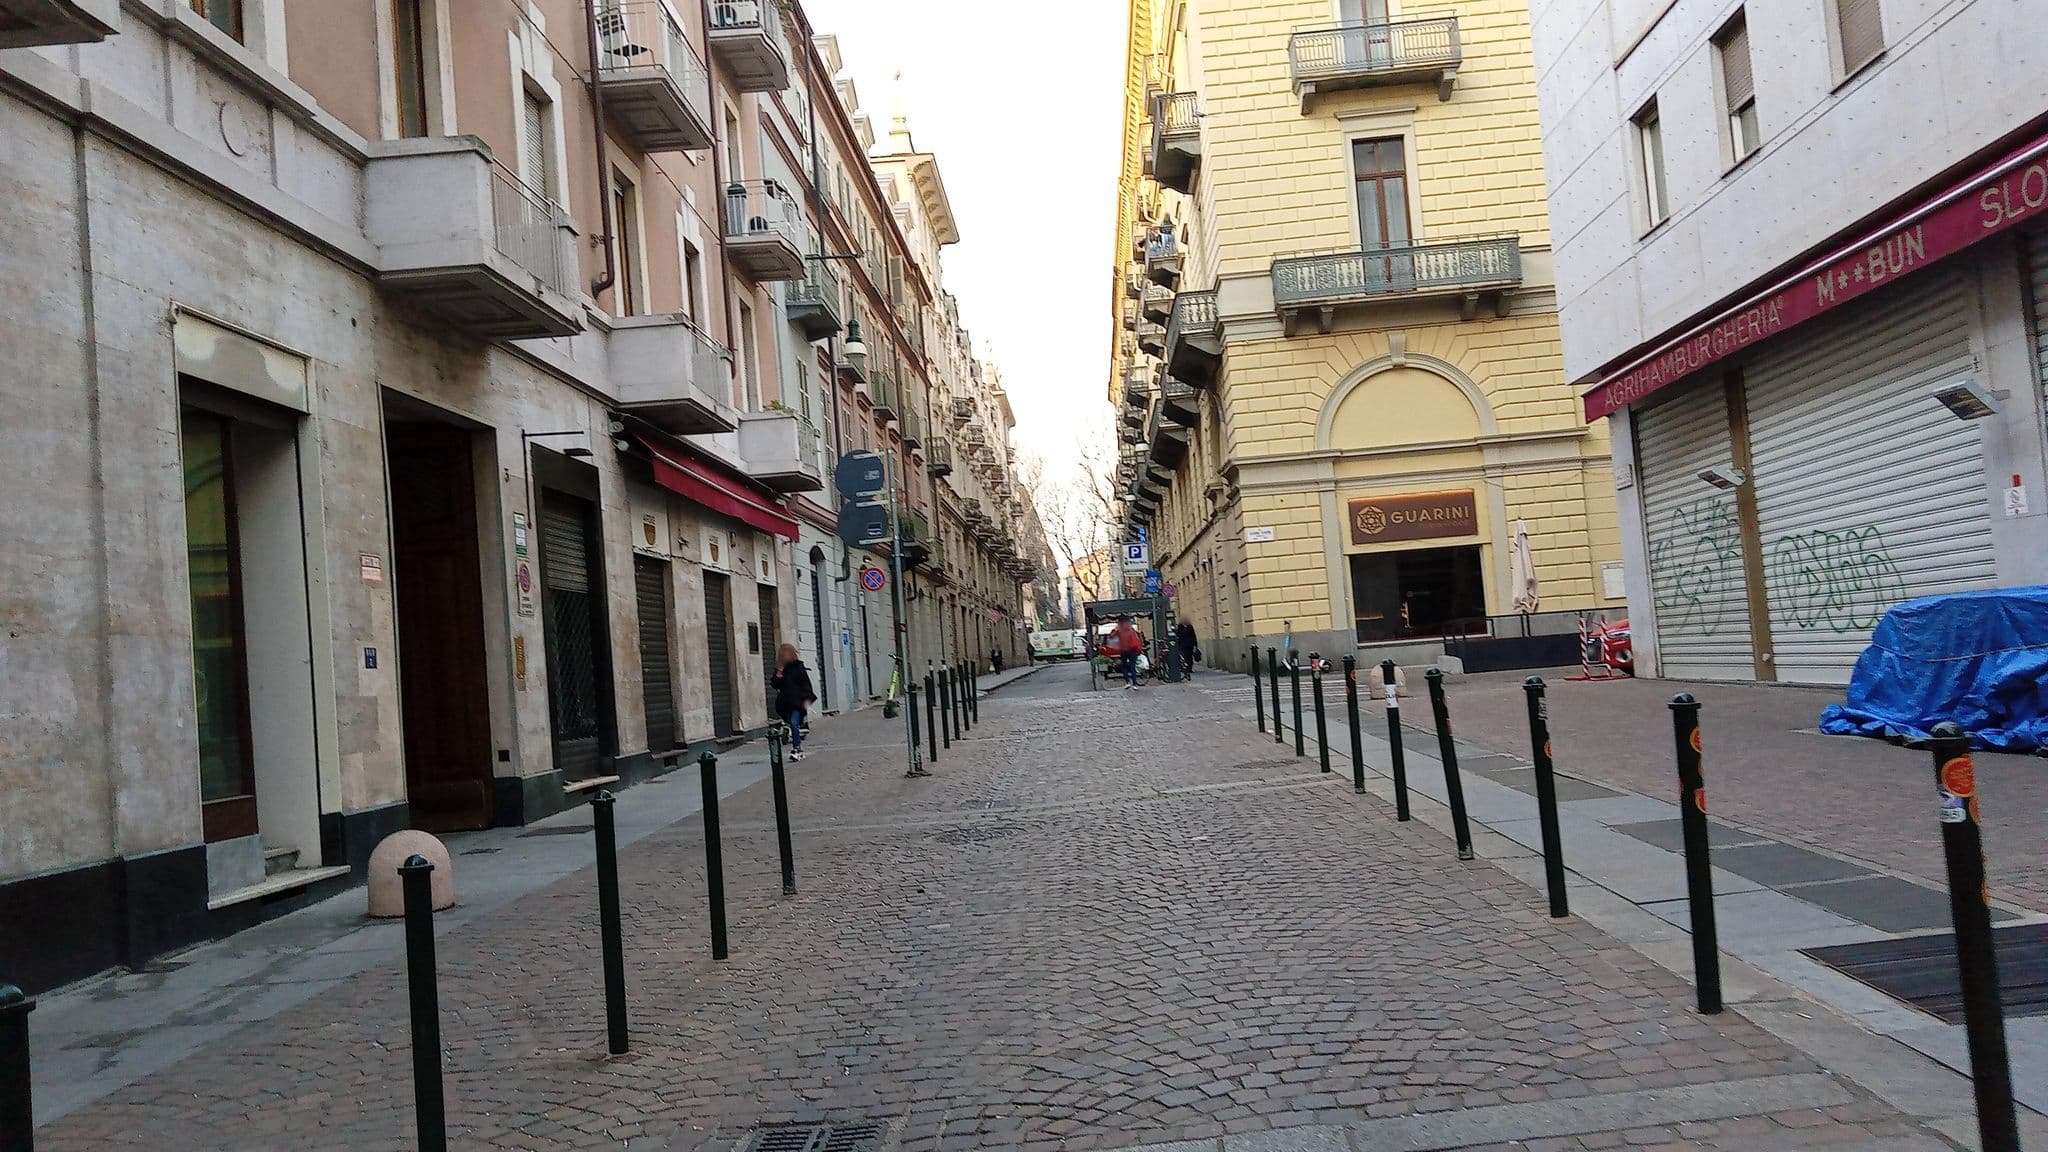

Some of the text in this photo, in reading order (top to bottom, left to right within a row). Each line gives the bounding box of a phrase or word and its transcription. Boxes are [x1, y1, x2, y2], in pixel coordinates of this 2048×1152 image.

[1979, 160, 2048, 228] SLO
[1391, 505, 1470, 524] GUARINI
[1130, 547, 1140, 557] P
